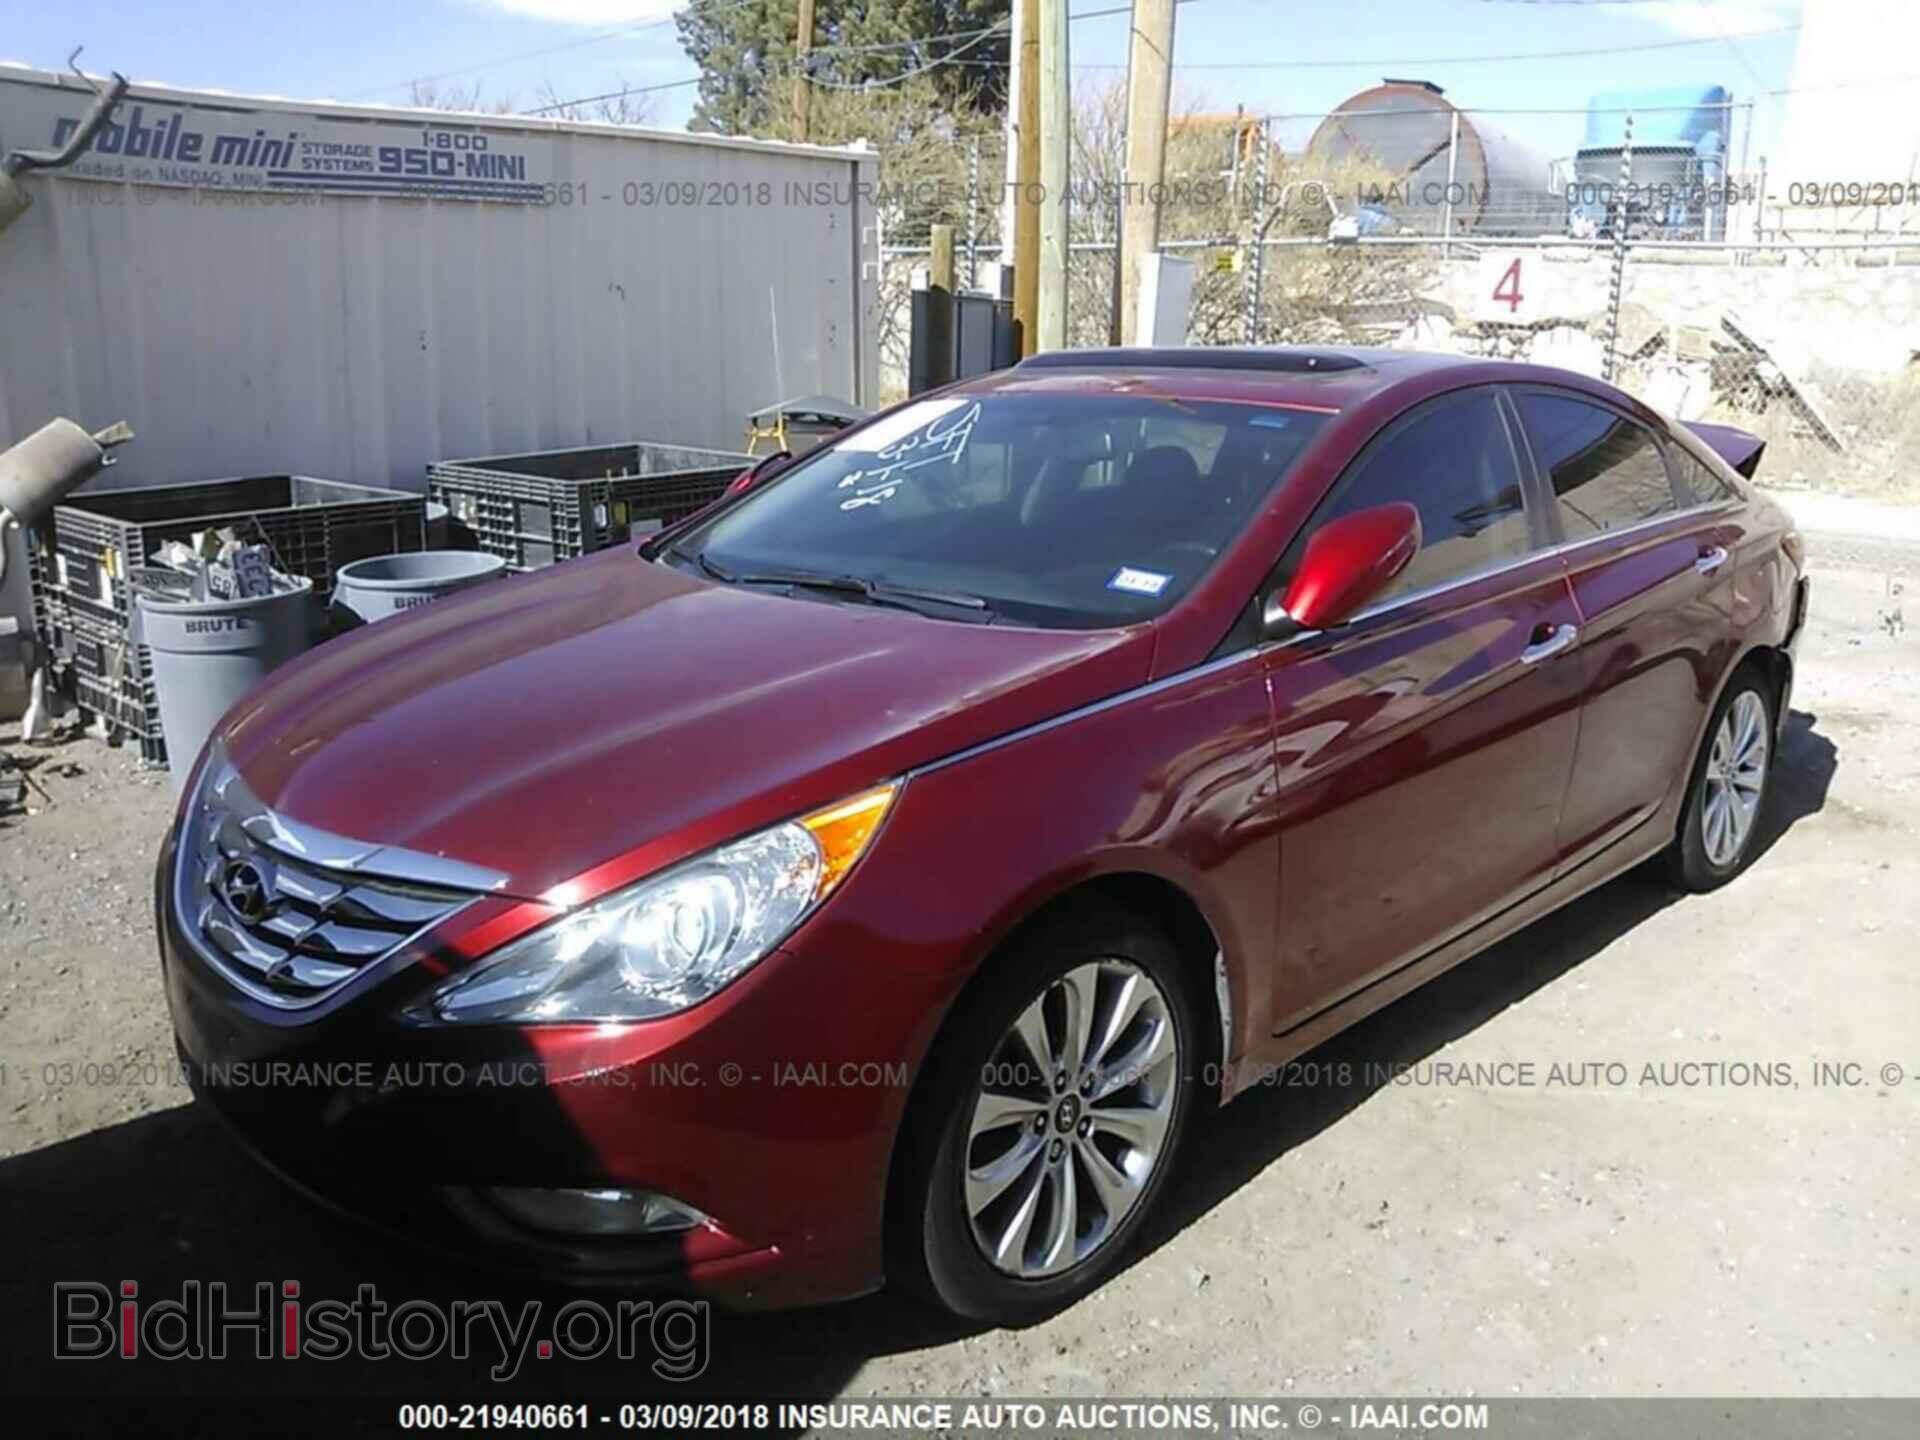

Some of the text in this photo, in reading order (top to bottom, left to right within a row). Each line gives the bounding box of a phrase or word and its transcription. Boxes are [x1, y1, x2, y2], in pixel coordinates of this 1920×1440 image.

[210, 129, 298, 169] mini
[301, 141, 373, 158] STORAGE
[301, 157, 374, 173] SYSTEMS
[378, 147, 526, 181] 950-MINI
[1493, 257, 1525, 313] 4
[184, 616, 252, 634] BRUTE
